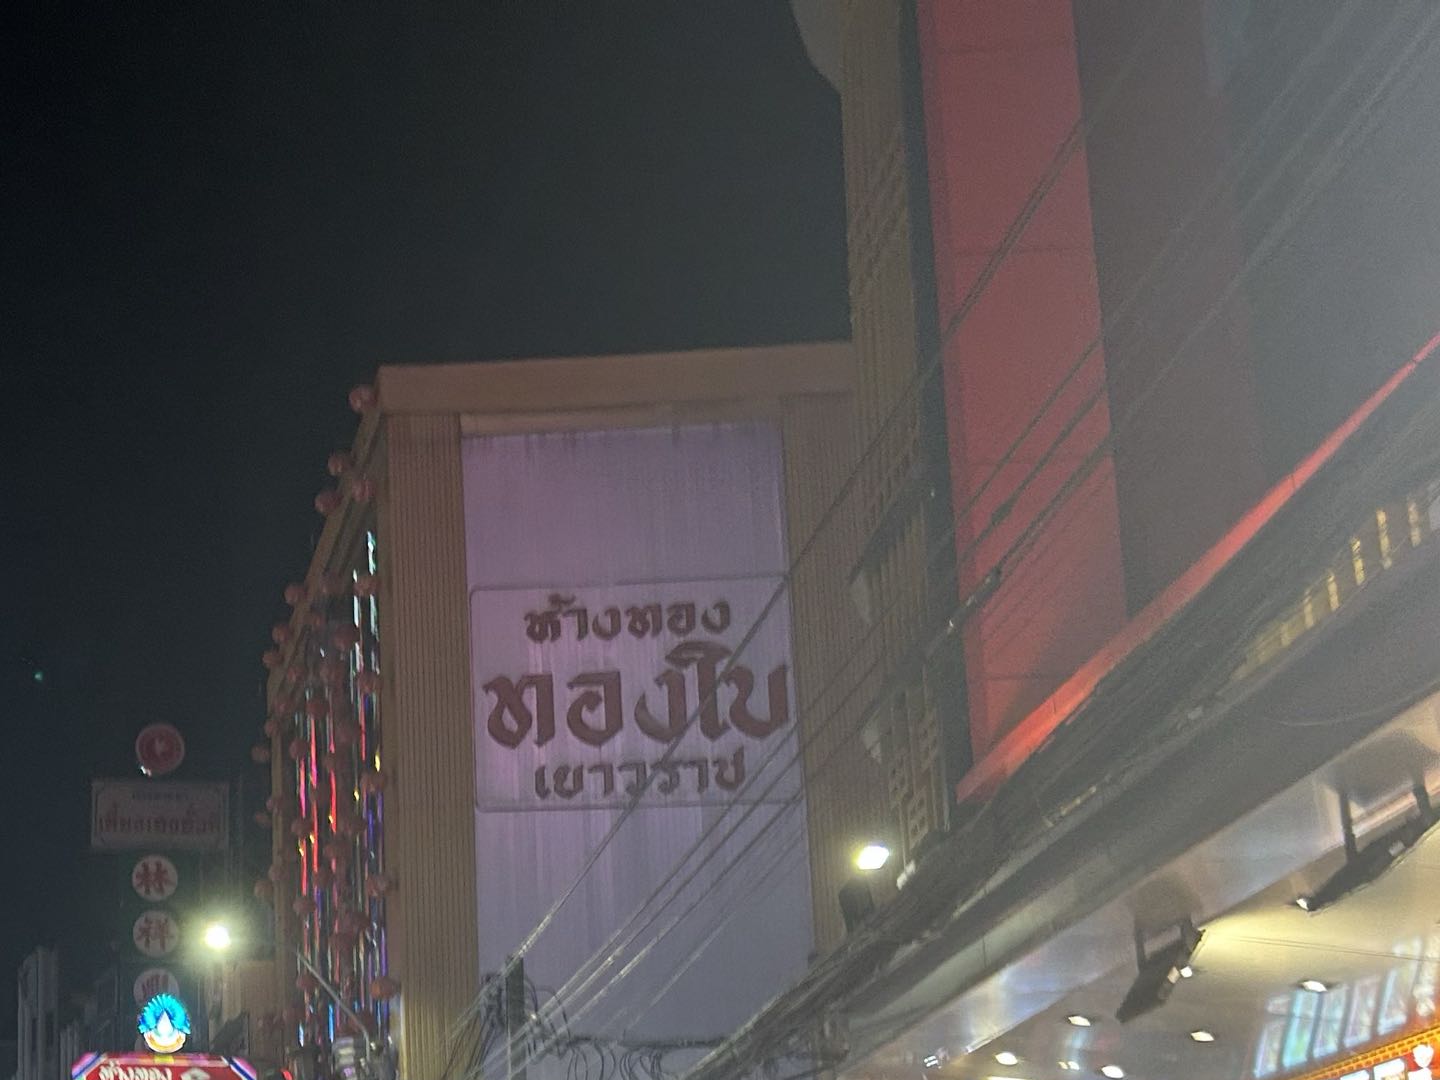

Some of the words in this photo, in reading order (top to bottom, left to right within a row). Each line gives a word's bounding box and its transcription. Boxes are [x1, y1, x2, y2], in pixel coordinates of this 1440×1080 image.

[523, 592, 733, 644] ห้างทอง
[533, 745, 745, 800] เยาวราช
